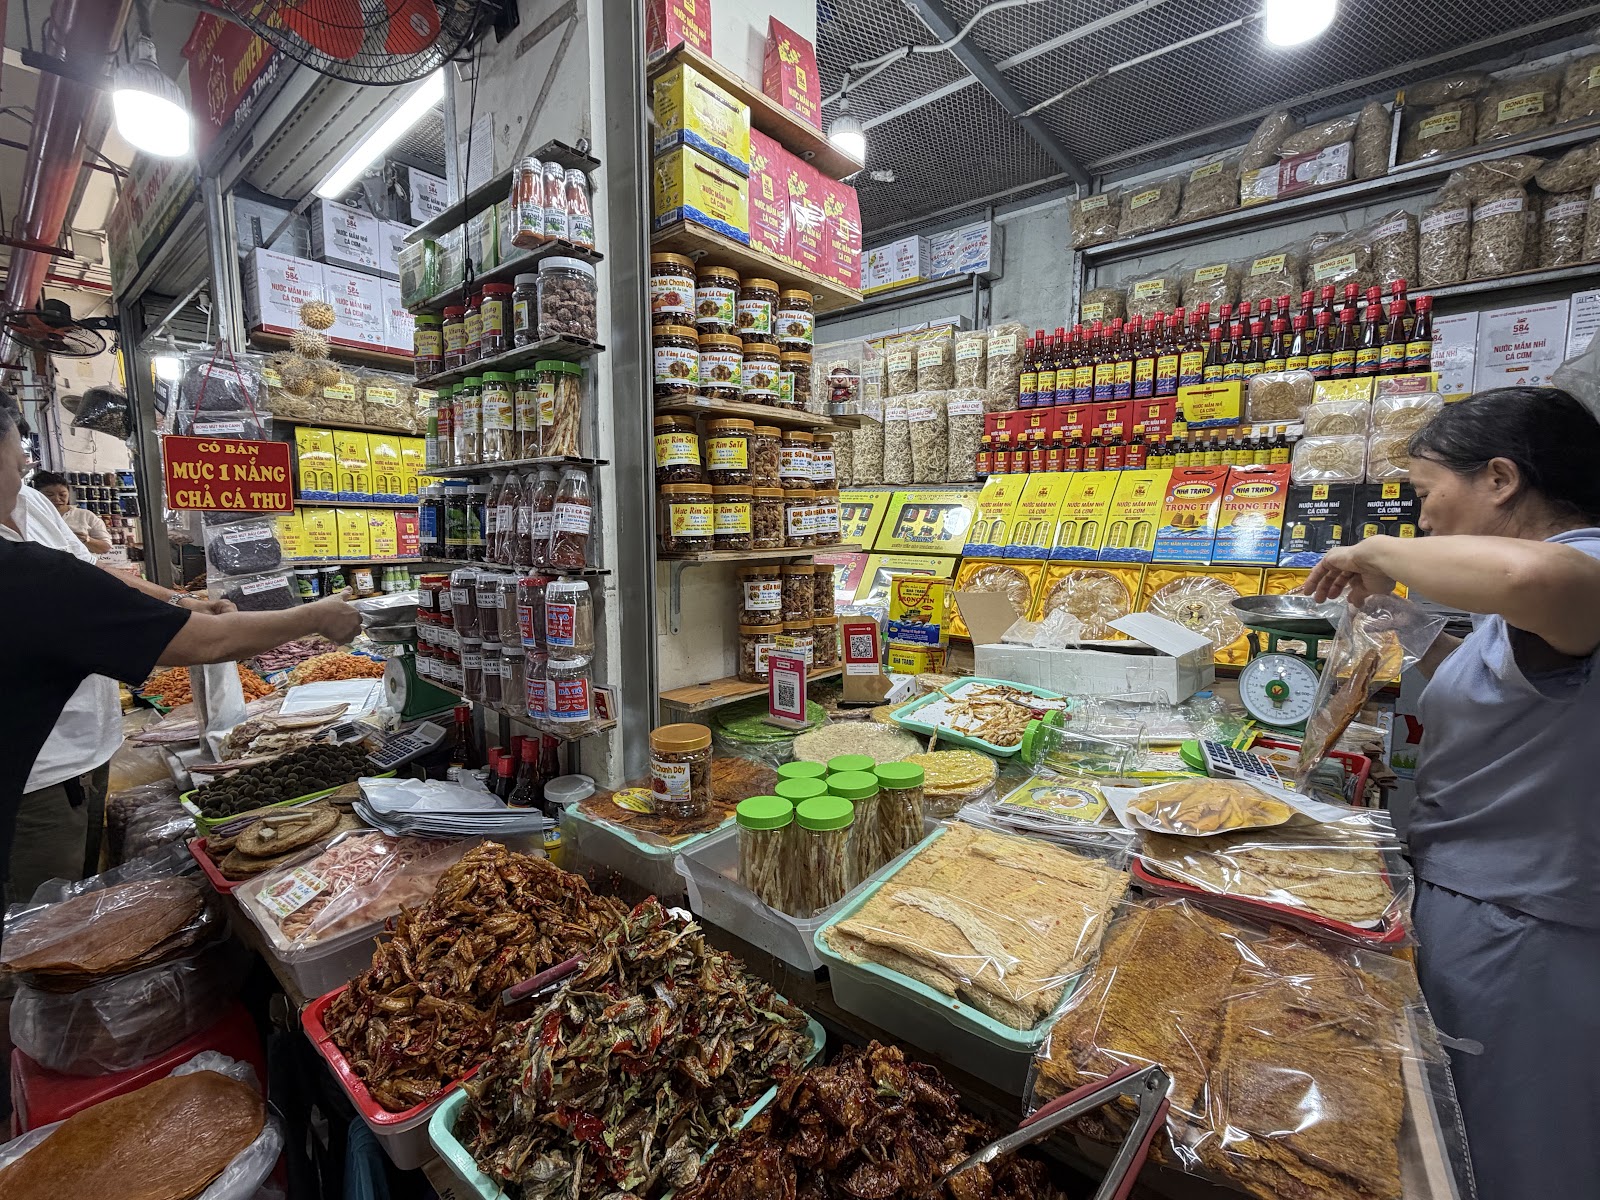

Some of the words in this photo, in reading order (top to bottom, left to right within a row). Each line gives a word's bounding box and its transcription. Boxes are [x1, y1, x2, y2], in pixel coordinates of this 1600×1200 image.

[285, 271, 299, 281] 584
[669, 279, 686, 287] Chanh
[347, 285, 359, 296] 584
[1512, 324, 1530, 333] 584
[1493, 344, 1512, 353] NƯỚC
[1513, 341, 1533, 351] MẮM
[1505, 352, 1515, 360] CÁ
[1516, 351, 1532, 359] CƠM
[671, 436, 684, 444] Rim
[715, 441, 728, 449] Rim
[197, 441, 220, 453] CÓ
[225, 442, 259, 455] BÁN
[171, 460, 214, 484] MỰC
[219, 464, 230, 481] 1
[233, 457, 286, 482] NẮNG
[175, 484, 216, 507] CHẢ
[220, 487, 246, 508] CÁ
[250, 492, 286, 509] THU
[1165, 503, 1197, 511] TRỌNG
[1224, 502, 1260, 511] TRỌNG
[1263, 500, 1282, 510] TÍN
[656, 764, 673, 773] Chanh
[673, 766, 686, 775] Dây
